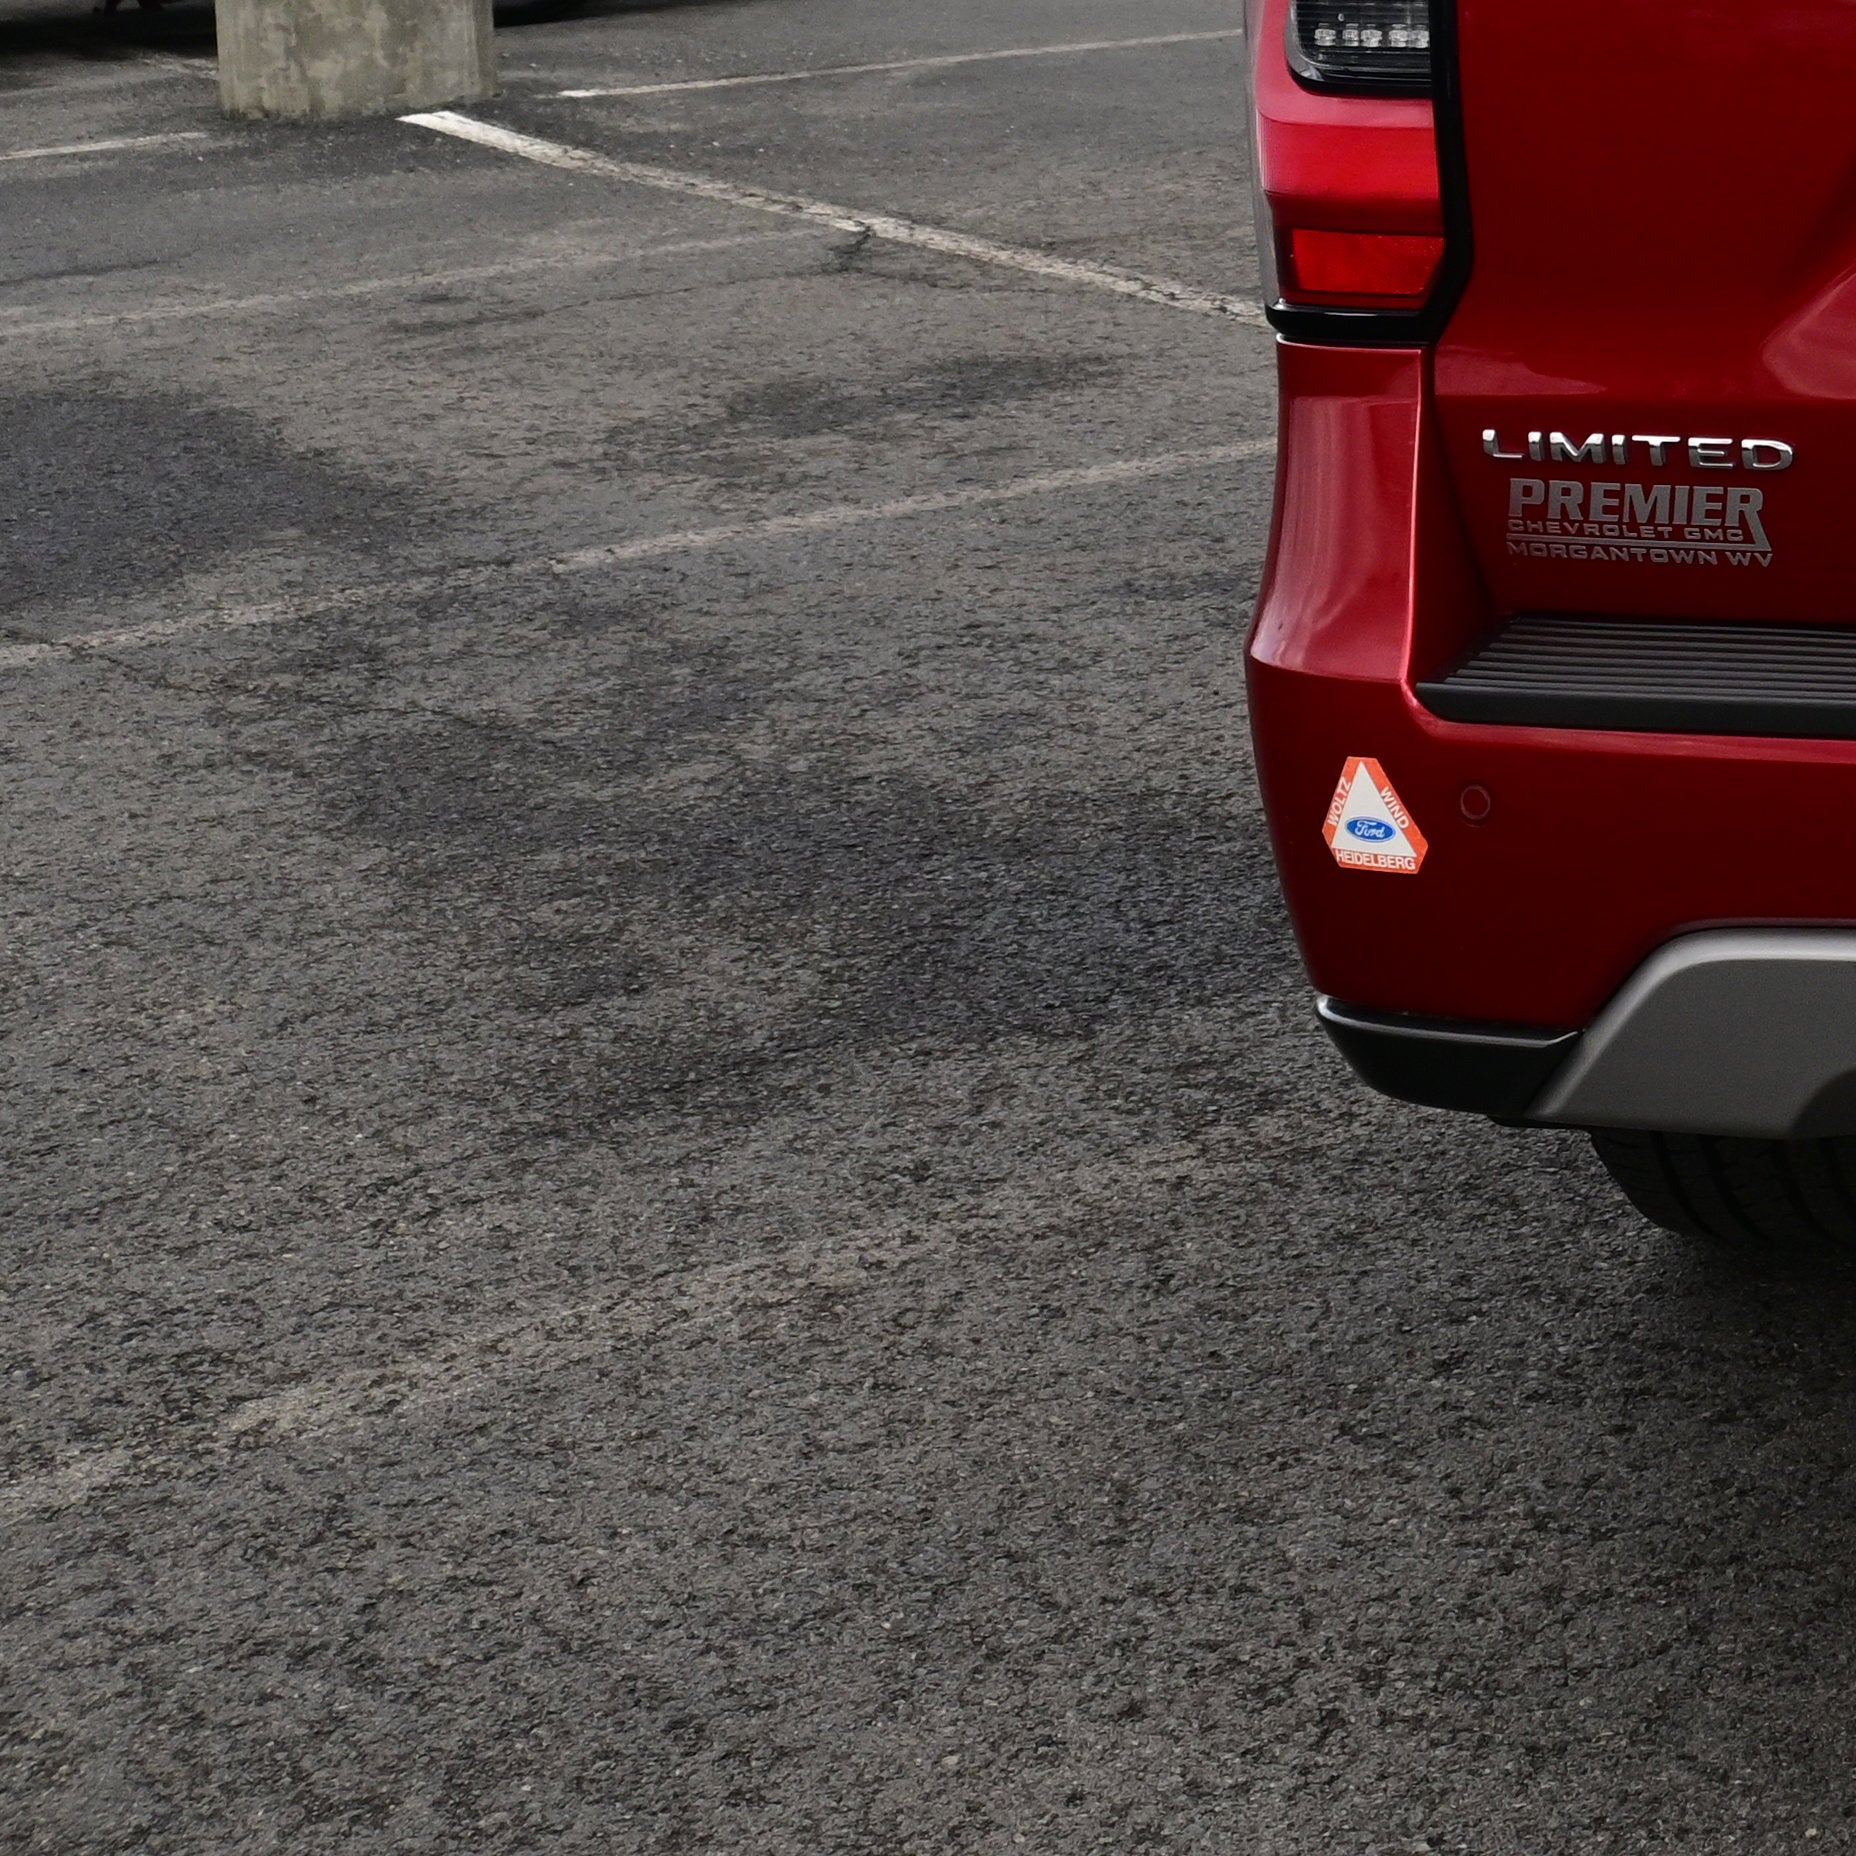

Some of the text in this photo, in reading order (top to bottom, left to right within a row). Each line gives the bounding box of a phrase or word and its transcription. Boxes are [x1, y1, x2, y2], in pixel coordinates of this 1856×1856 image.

[1482, 429, 1794, 471] LIMITED
[1508, 477, 1770, 539] PREMIER
[1507, 519, 1744, 542] CHEVROLET GMC
[1506, 541, 1773, 568] MORGANTOWN WV
[1327, 776, 1351, 827] WOLTZ
[1380, 786, 1410, 829] WIND
[1355, 820, 1386, 838] Ford
[1335, 849, 1416, 870] HEIDELBERG
